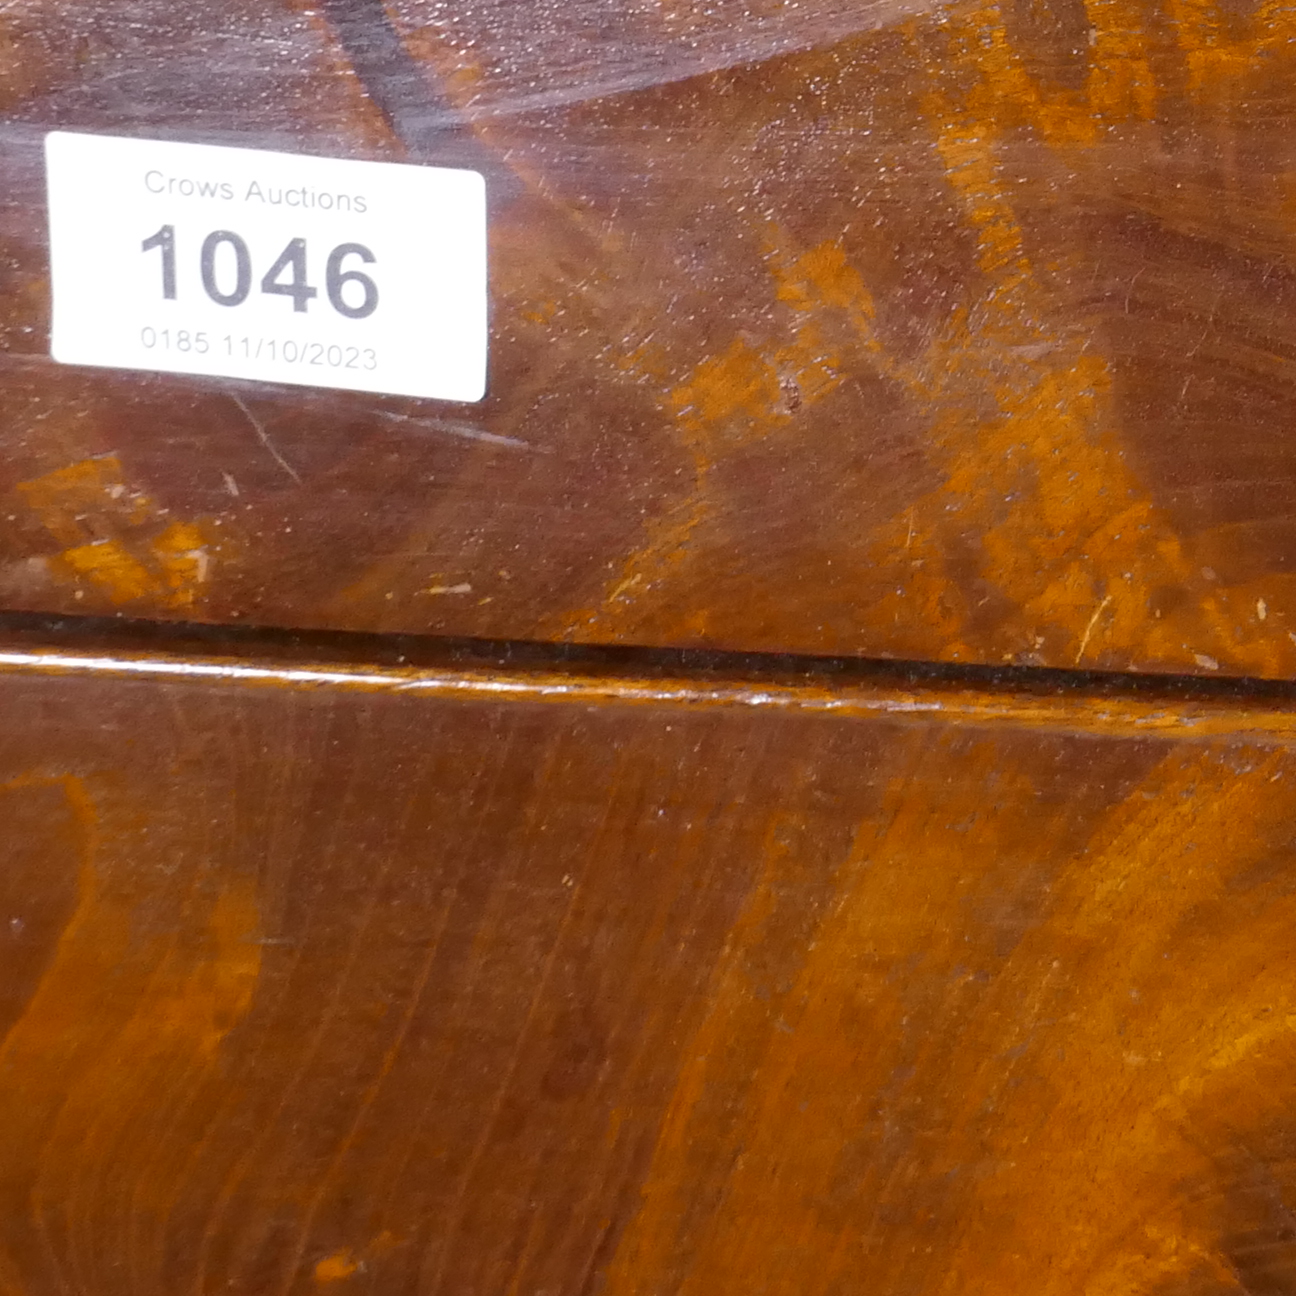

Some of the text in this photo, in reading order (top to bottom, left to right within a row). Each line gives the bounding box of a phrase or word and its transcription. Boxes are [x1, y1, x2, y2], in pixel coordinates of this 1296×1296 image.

[144, 170, 368, 213] Crows Auctions
[141, 224, 380, 320] 1046
[140, 326, 378, 371] 0185 11/10/2023
